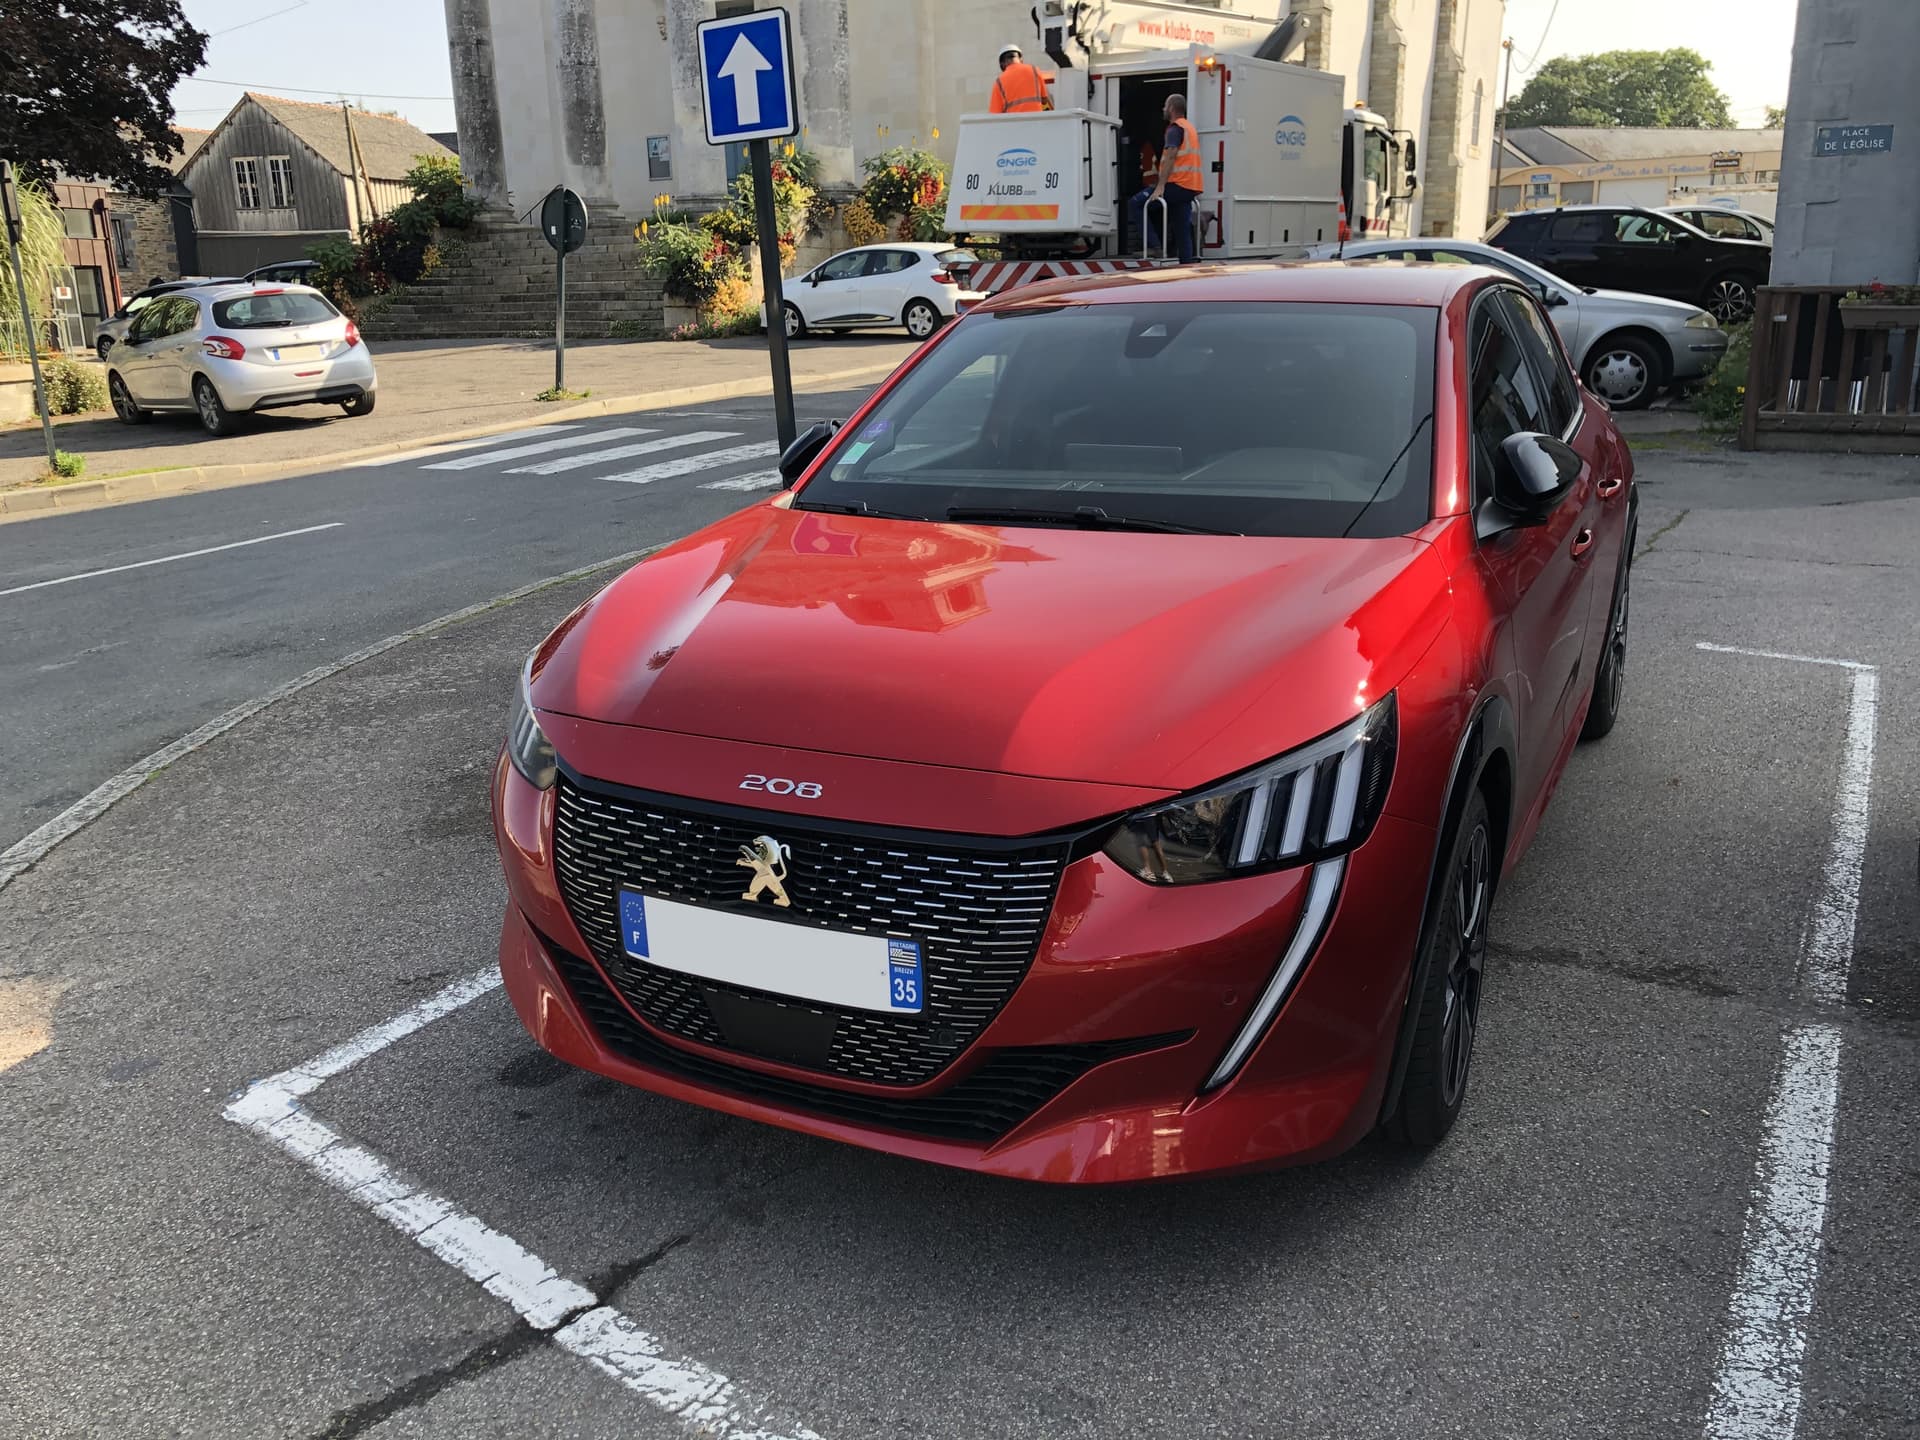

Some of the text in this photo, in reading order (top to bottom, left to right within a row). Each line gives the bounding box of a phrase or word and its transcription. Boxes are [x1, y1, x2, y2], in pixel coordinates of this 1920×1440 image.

[1138, 20, 1215, 43] www.klubb.com
[1841, 128, 1870, 137] PLACE
[1824, 141, 1838, 151] DE
[966, 174, 980, 190] 80
[1045, 172, 1059, 189] 90
[739, 774, 823, 799] 208
[632, 930, 641, 945] F
[889, 941, 916, 951] BRETAGNE
[894, 966, 914, 976] BREIZH
[894, 977, 917, 1003] 35
